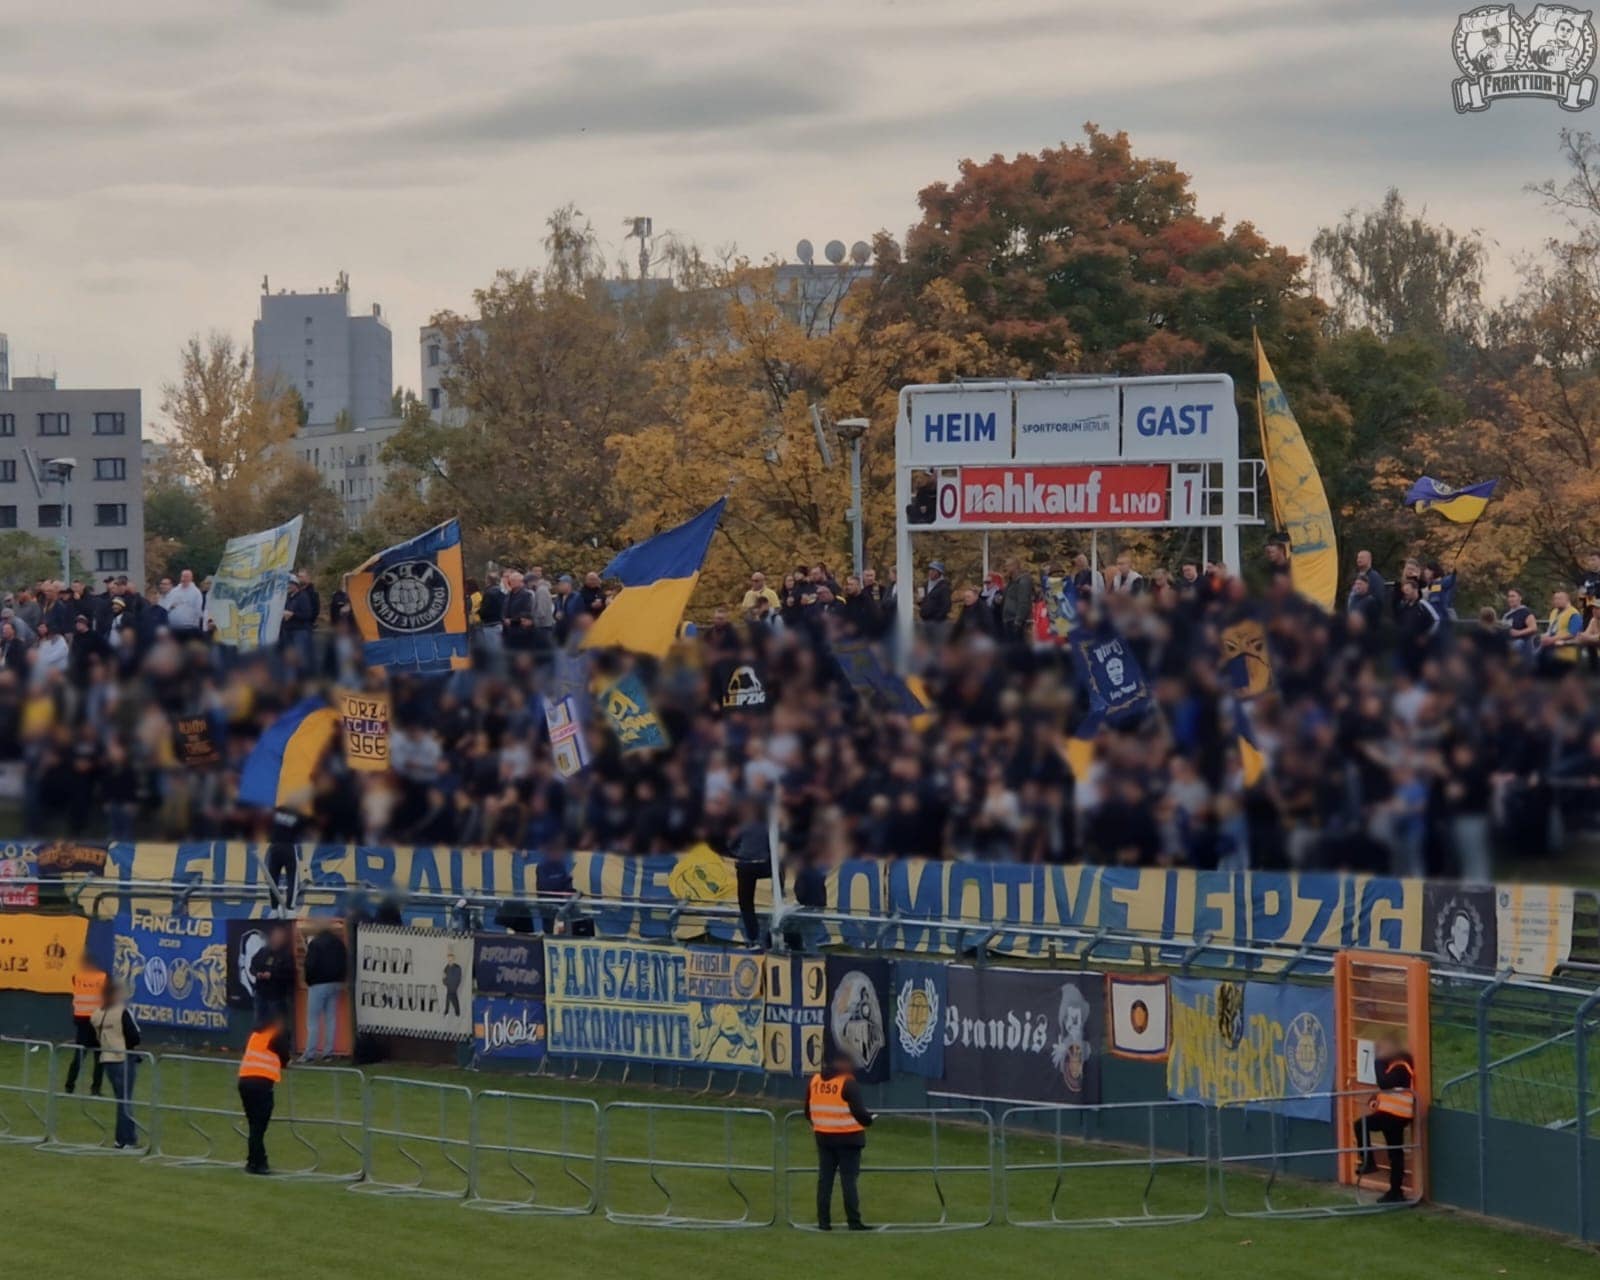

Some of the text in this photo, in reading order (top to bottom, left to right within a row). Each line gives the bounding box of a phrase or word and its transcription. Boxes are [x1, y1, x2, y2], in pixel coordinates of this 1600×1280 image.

[925, 412, 996, 442] HEIM
[1022, 421, 1082, 434] SPORTFORUM
[1136, 404, 1214, 436] GAST
[940, 483, 957, 519] 0
[965, 471, 1161, 514] nahkauf LIND
[1183, 479, 1192, 515] 1
[722, 692, 767, 708] LEIPZIG
[131, 914, 213, 937] FANCLUB
[1158, 869, 1404, 972] LEIPZIG
[547, 945, 688, 1005] FANSZENE
[549, 1006, 692, 1058] LOKOMOTIVE
[944, 1003, 1049, 1053] Brandis
